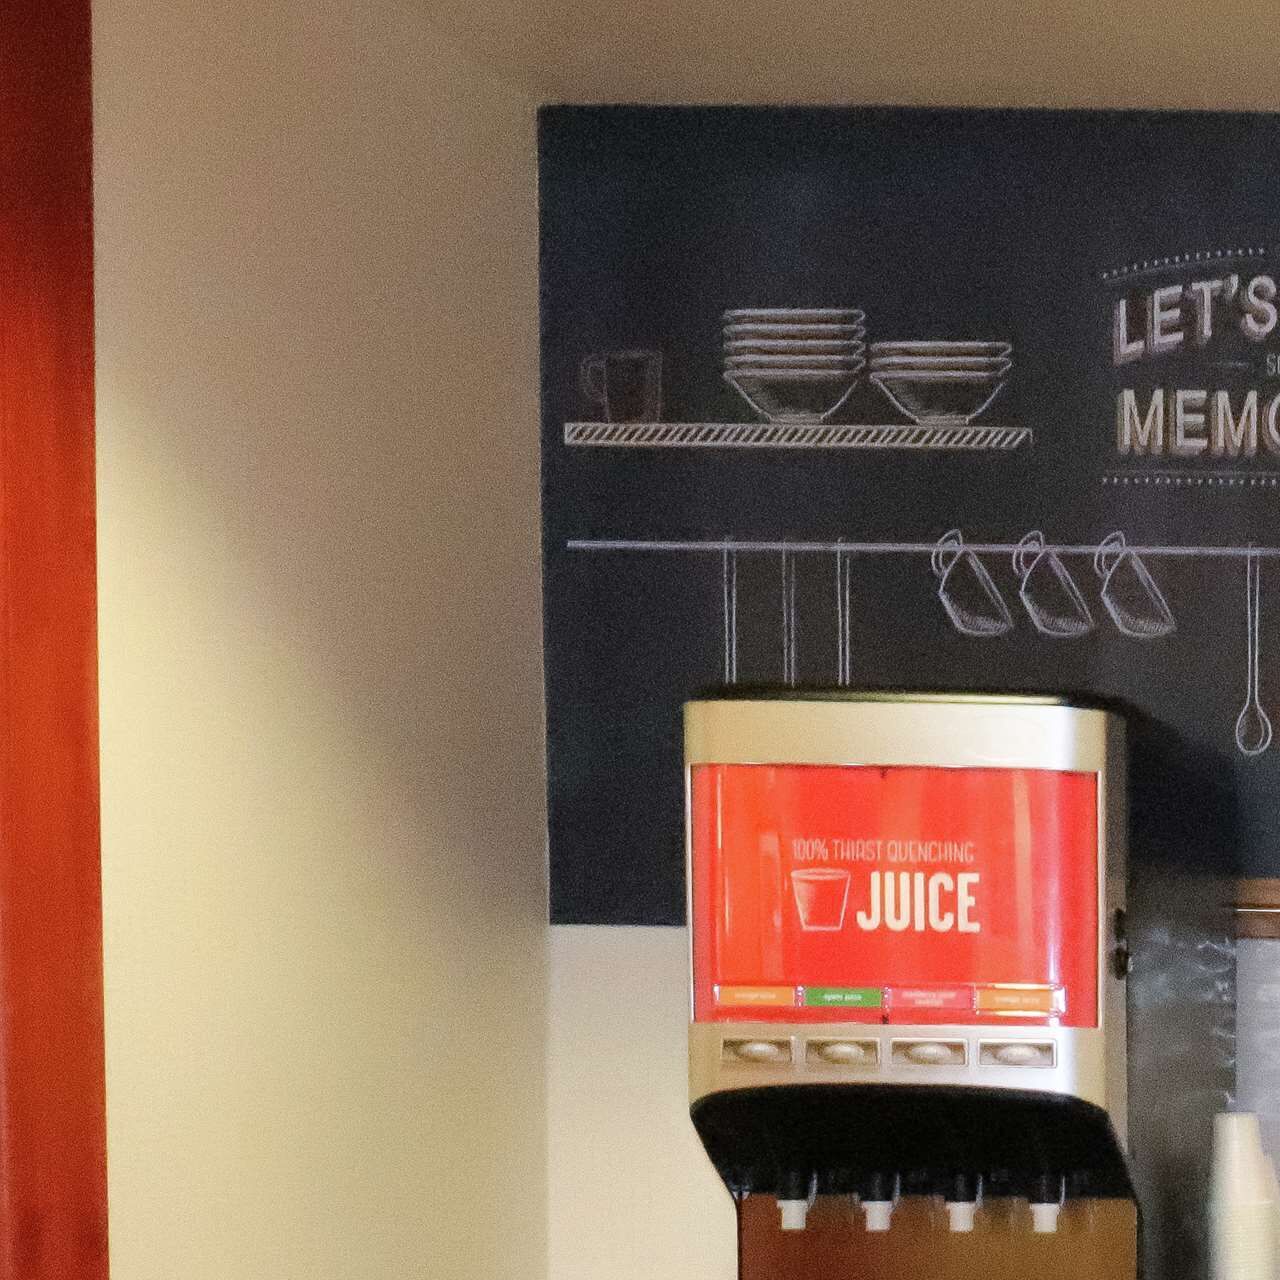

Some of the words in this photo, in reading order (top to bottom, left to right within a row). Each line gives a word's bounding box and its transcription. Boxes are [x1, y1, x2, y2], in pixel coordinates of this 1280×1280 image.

[1113, 273, 1278, 366] LET'S
[791, 838, 828, 862] 100%
[831, 838, 881, 862] THIRST
[885, 839, 975, 863] QUENCHING
[856, 870, 981, 933] JUICE
